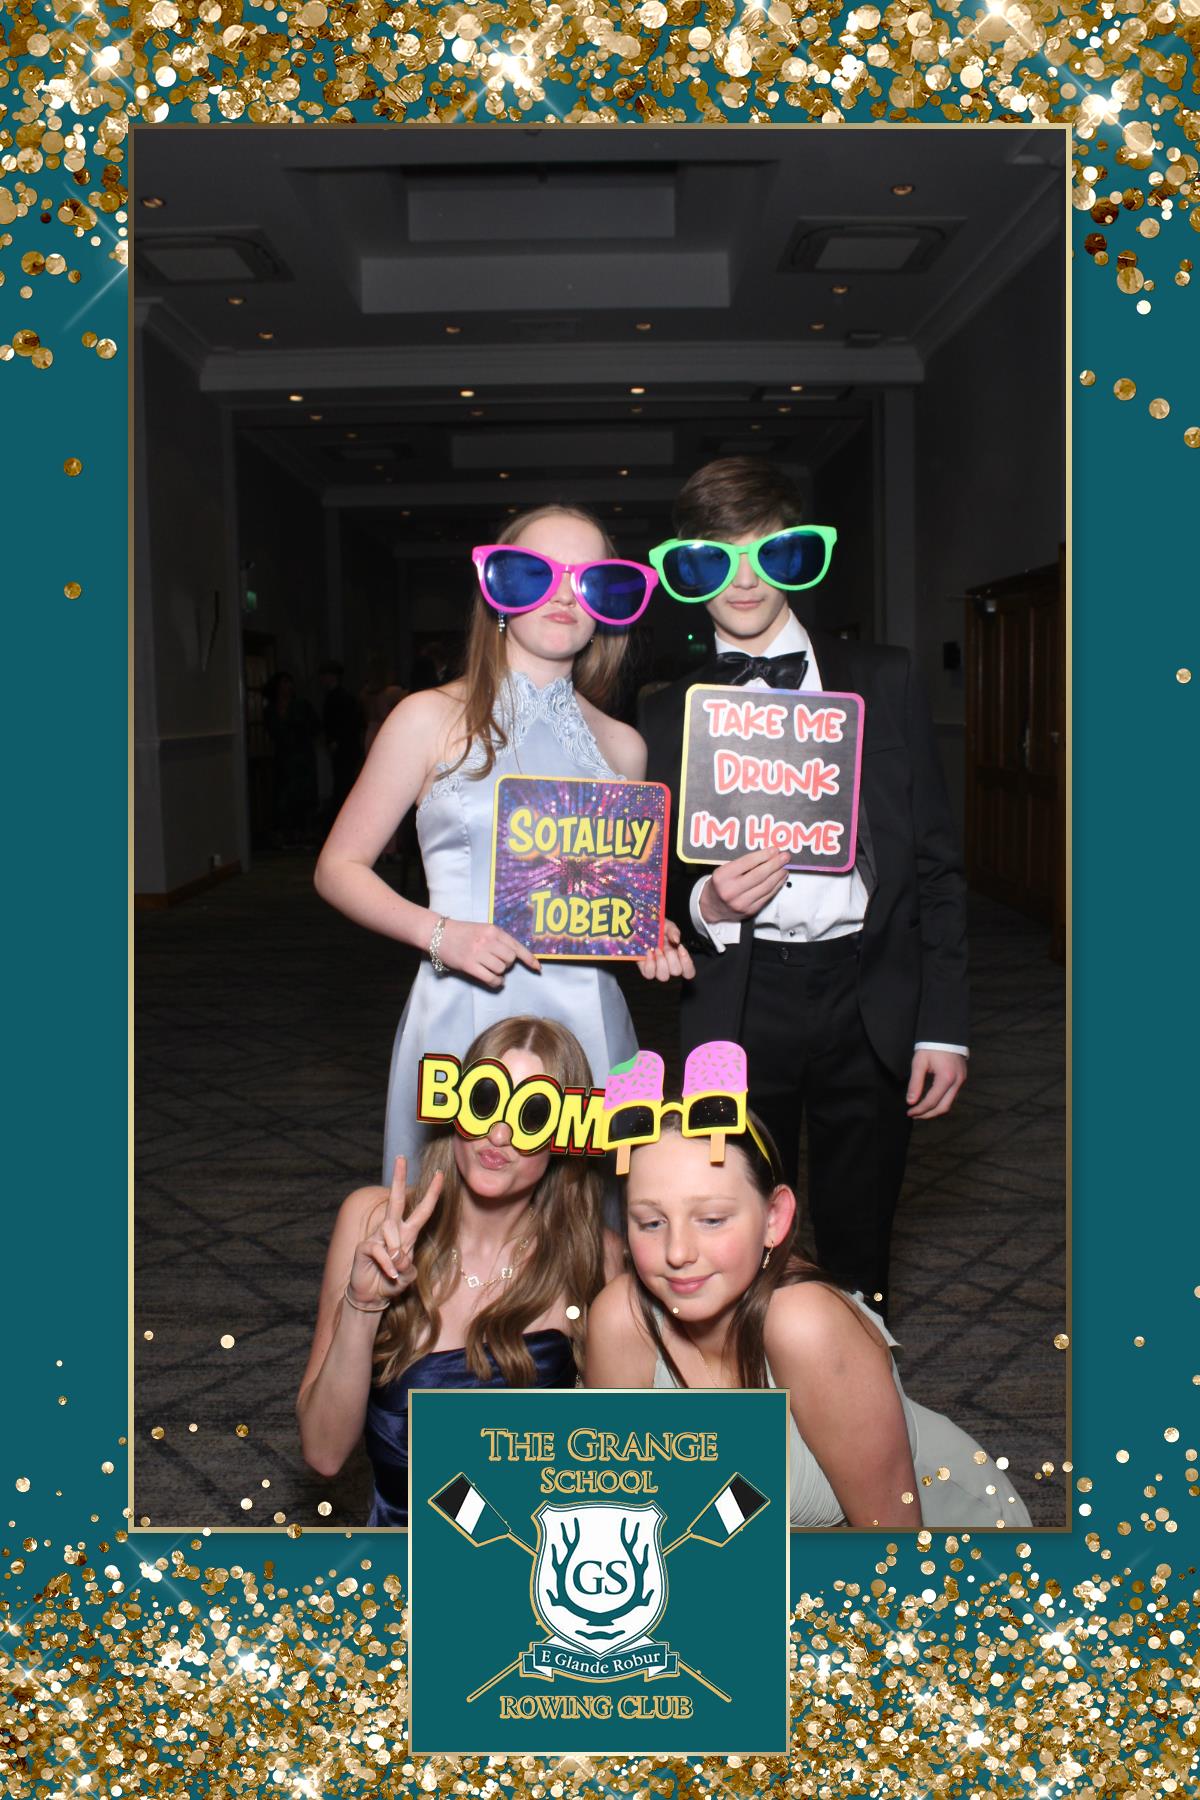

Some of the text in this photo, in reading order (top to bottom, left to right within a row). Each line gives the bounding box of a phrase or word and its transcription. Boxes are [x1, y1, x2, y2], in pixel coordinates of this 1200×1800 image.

[703, 700, 847, 743] TAKE ME
[713, 749, 840, 801] DRUNK
[508, 808, 656, 861] SOTALLY
[689, 811, 845, 855] I'M HOME
[530, 889, 636, 940] TOBER
[416, 1053, 606, 1157] BOOM
